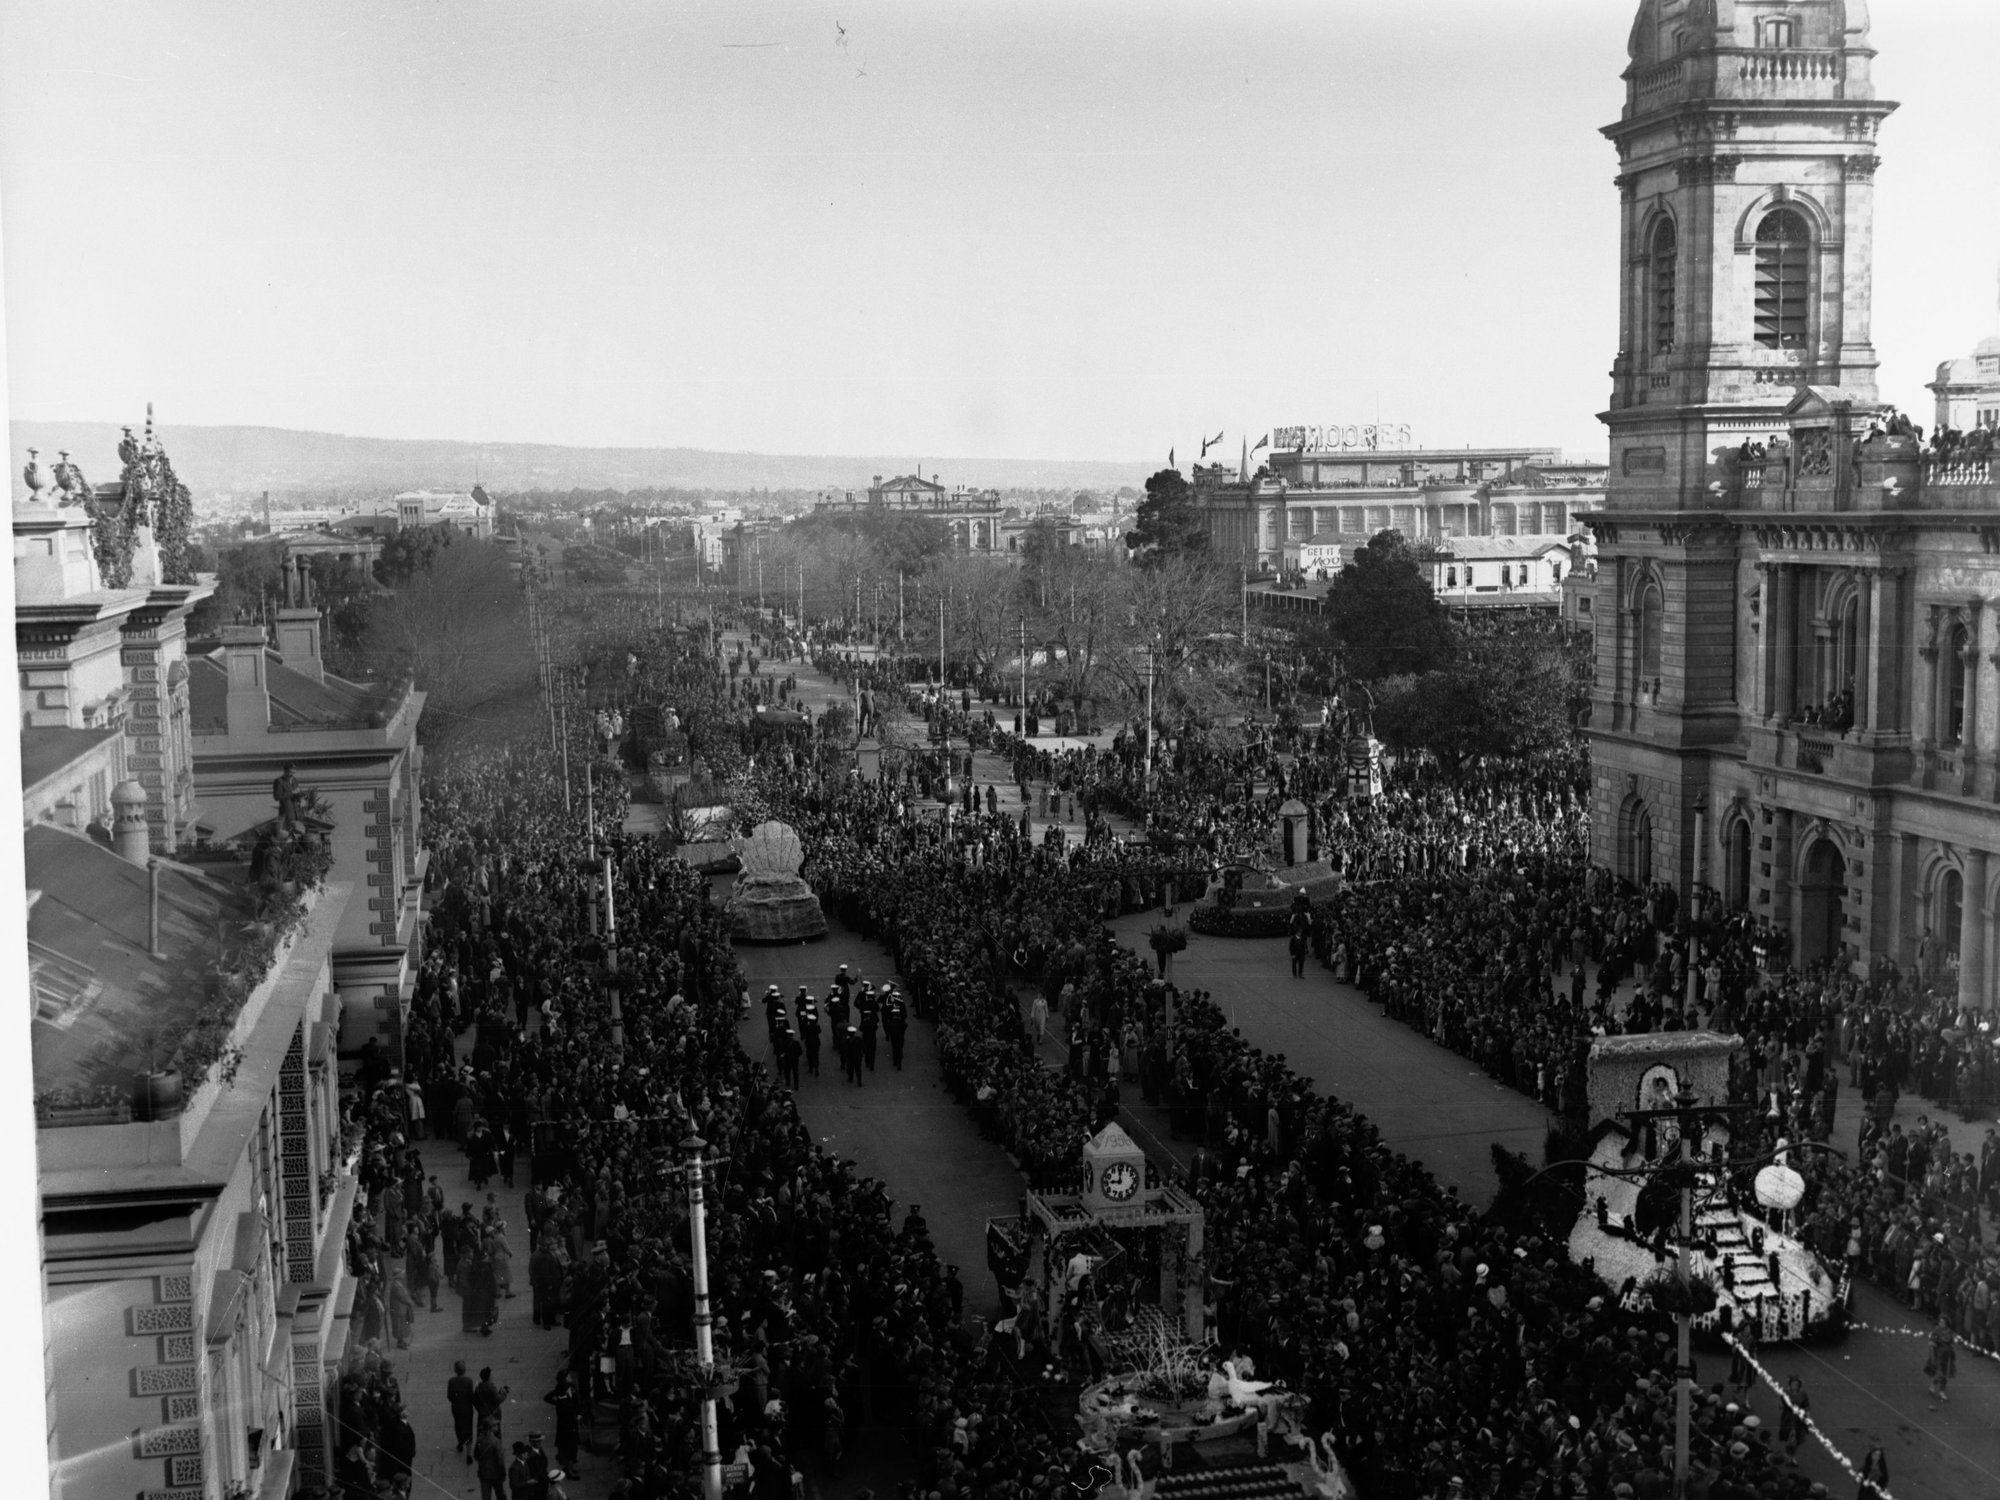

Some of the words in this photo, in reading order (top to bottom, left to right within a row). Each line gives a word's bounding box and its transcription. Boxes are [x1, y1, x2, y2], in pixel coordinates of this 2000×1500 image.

[1307, 423, 1411, 448] MOORES
[1307, 547, 1323, 556] GET
[1326, 547, 1334, 556] IT
